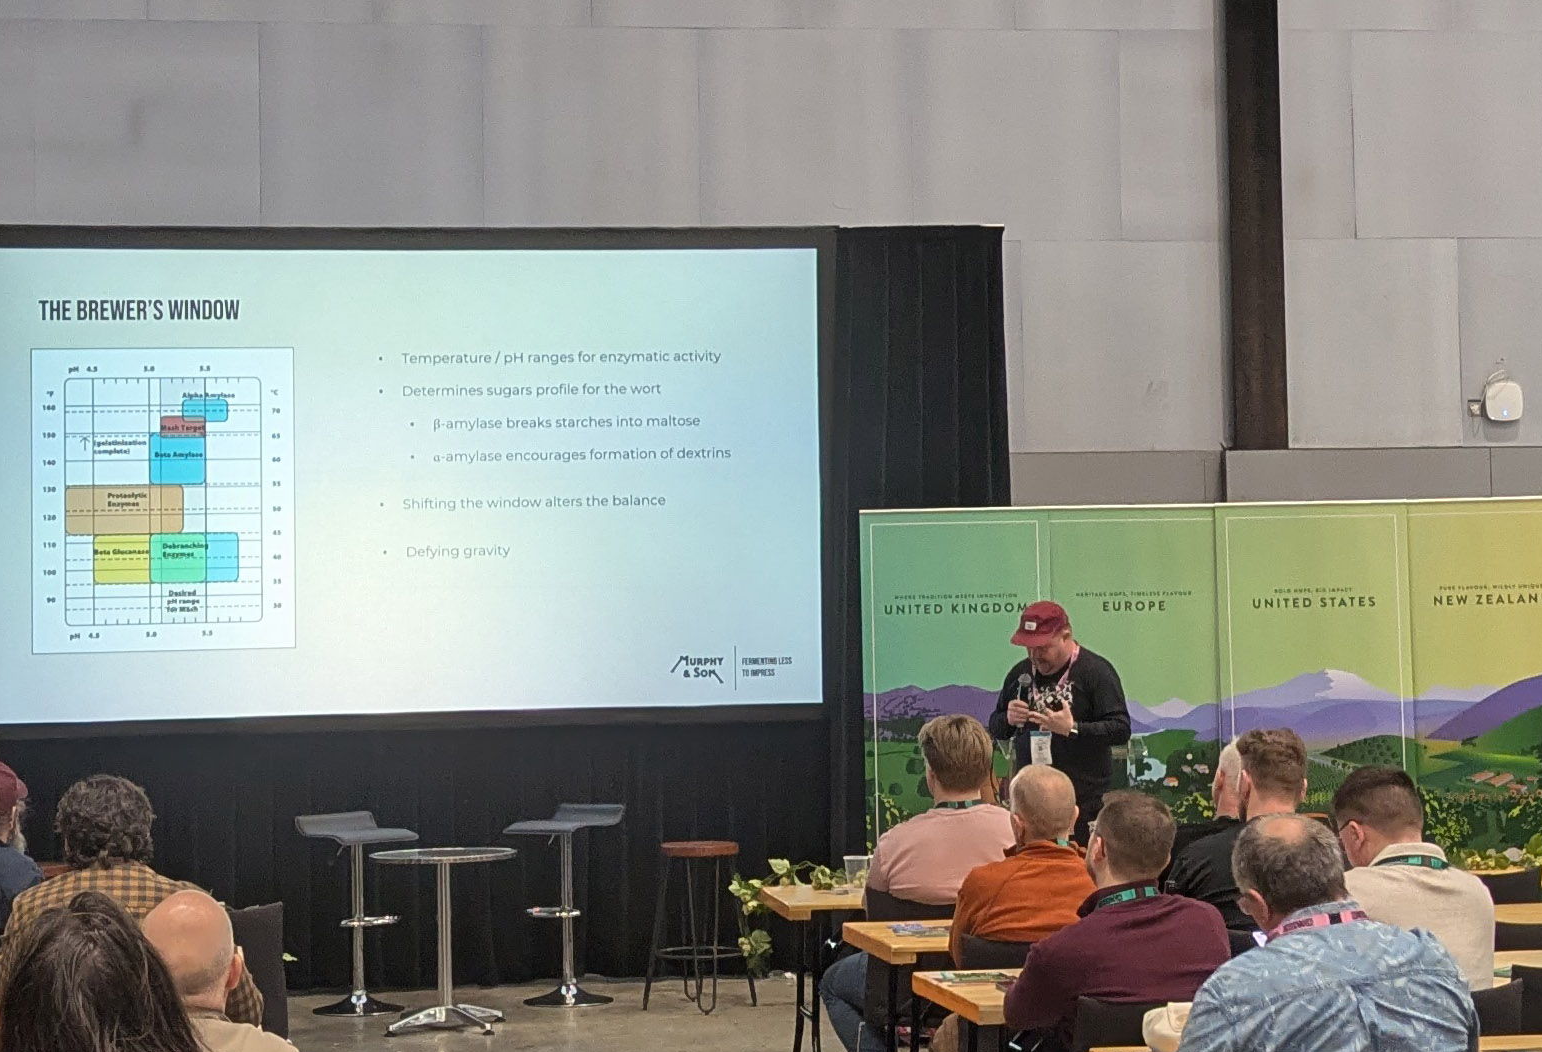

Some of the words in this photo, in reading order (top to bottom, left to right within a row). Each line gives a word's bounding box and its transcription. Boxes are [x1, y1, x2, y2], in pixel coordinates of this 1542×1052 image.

[39, 300, 72, 320] THE
[76, 299, 164, 320] BREWER'S
[168, 299, 239, 320] WINDOW
[401, 352, 492, 366] Temperature
[495, 350, 501, 364] /
[504, 352, 524, 367] pH
[527, 353, 574, 367] ranges
[577, 350, 597, 364] for
[599, 350, 670, 366] enzymatic
[673, 350, 722, 365] activity
[402, 384, 484, 398] Determines
[486, 385, 533, 400] sugars
[535, 382, 579, 399] profile
[582, 382, 601, 396] for
[604, 382, 627, 395] the
[630, 382, 662, 395] wort
[506, 416, 552, 429] breaks
[555, 415, 613, 428] starches
[616, 415, 643, 428] into
[646, 415, 701, 428] maltose
[505, 450, 587, 464] encourages
[589, 447, 657, 460] formation
[659, 447, 675, 460] of
[676, 446, 732, 460] dextrins
[403, 497, 457, 512] Shifting
[460, 497, 484, 510] the
[487, 496, 542, 509] window
[545, 496, 583, 508] alters
[586, 495, 609, 508] the
[612, 494, 667, 507] balance
[406, 546, 460, 561] Defying
[463, 544, 511, 559] gravity
[1102, 600, 1167, 612] EUROPE
[1252, 597, 1313, 609] UNITED
[1319, 596, 1377, 608] STATES
[1433, 595, 1468, 606] NEW
[884, 604, 943, 616] UNITED
[951, 602, 1027, 614] KINGDOM
[778, 657, 793, 665] LESS
[683, 670, 691, 678] &
[741, 669, 749, 677] TO
[750, 668, 775, 676] IMPRESS
